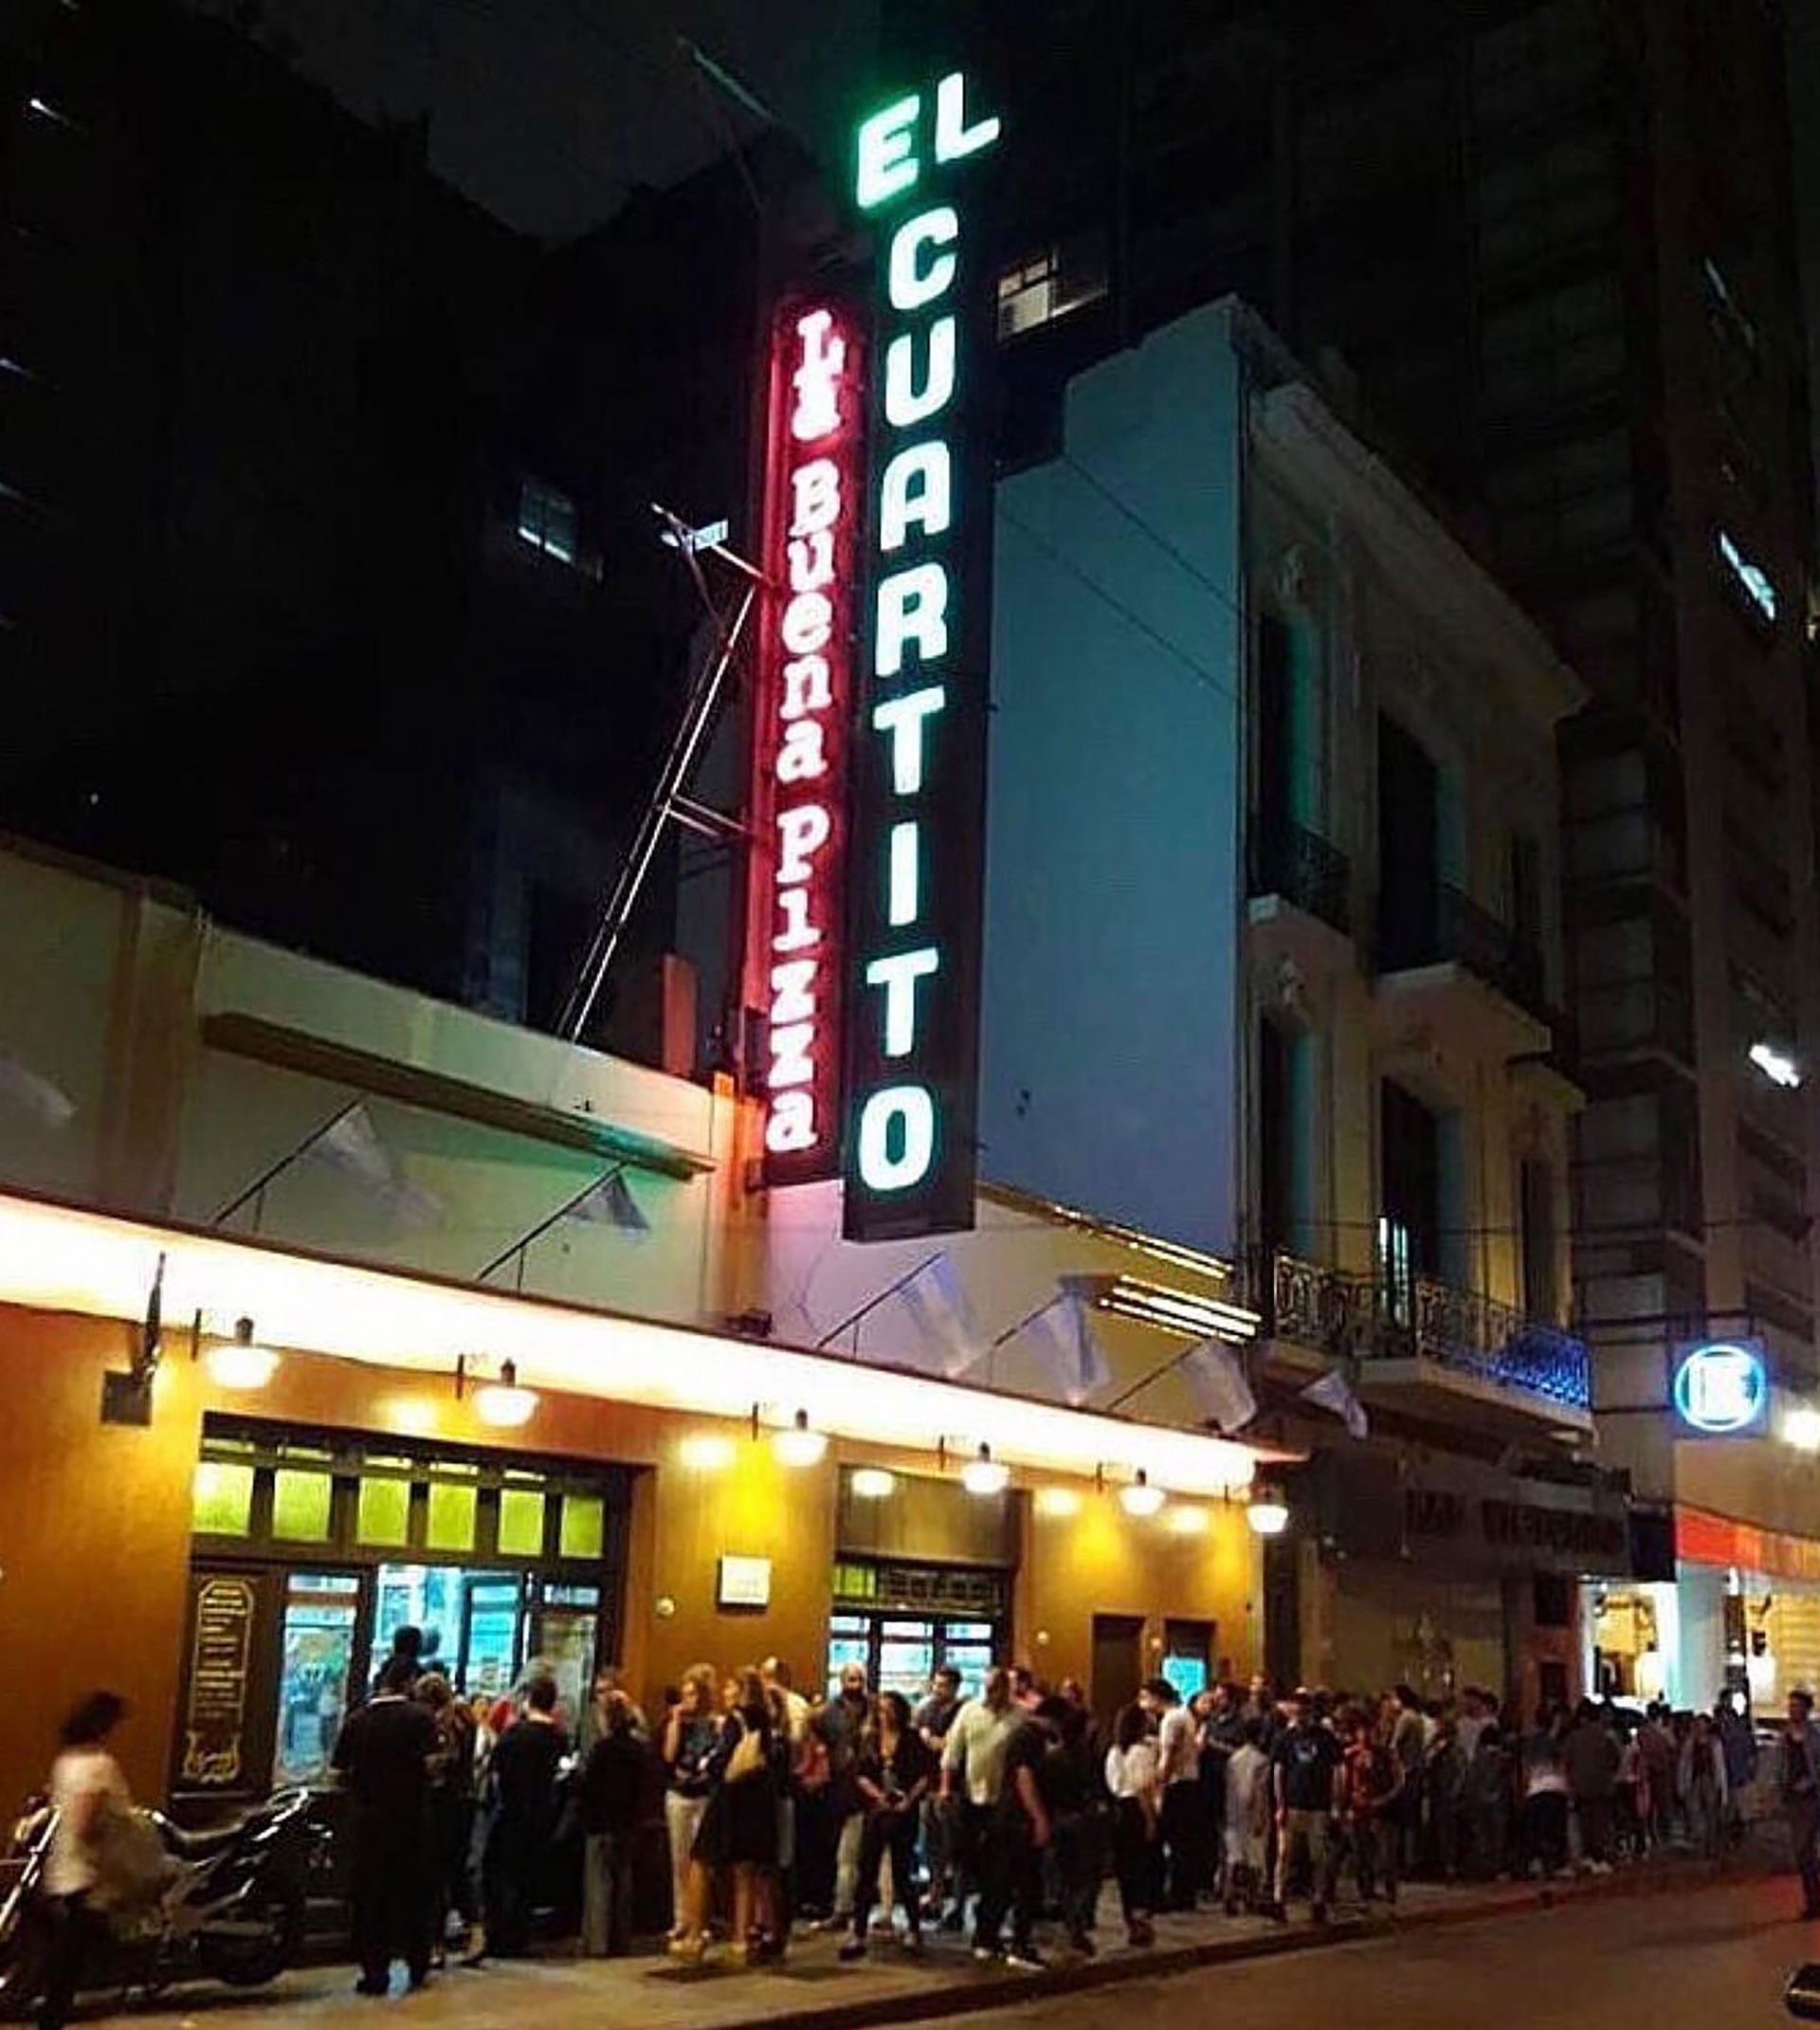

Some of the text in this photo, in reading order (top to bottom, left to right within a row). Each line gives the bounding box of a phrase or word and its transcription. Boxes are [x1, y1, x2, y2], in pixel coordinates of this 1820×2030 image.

[856, 71, 1001, 209] EL
[777, 458, 841, 780] Buena
[859, 206, 959, 1192] CUARTITO
[765, 803, 830, 1153] Pizza
